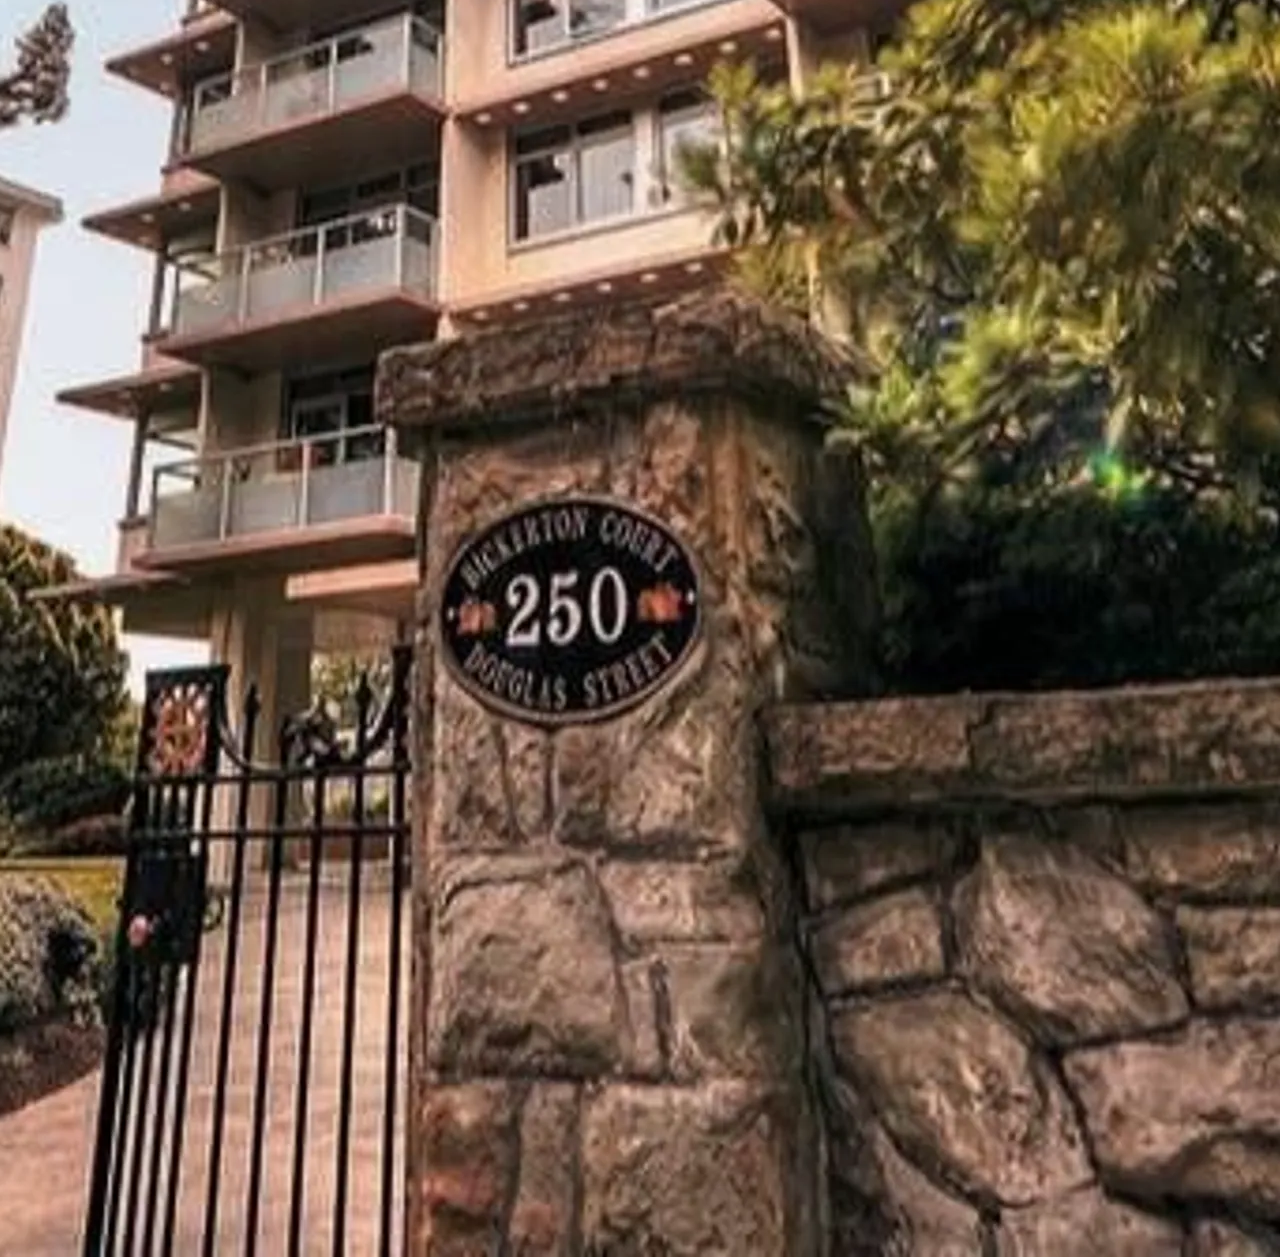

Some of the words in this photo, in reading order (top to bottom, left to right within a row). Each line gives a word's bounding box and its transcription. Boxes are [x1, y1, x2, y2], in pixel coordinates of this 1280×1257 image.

[459, 505, 590, 590] BICKERTON
[598, 511, 678, 573] COURT
[504, 566, 629, 648] 250
[463, 640, 568, 710] DOUGLAS
[582, 630, 673, 708] STREET
